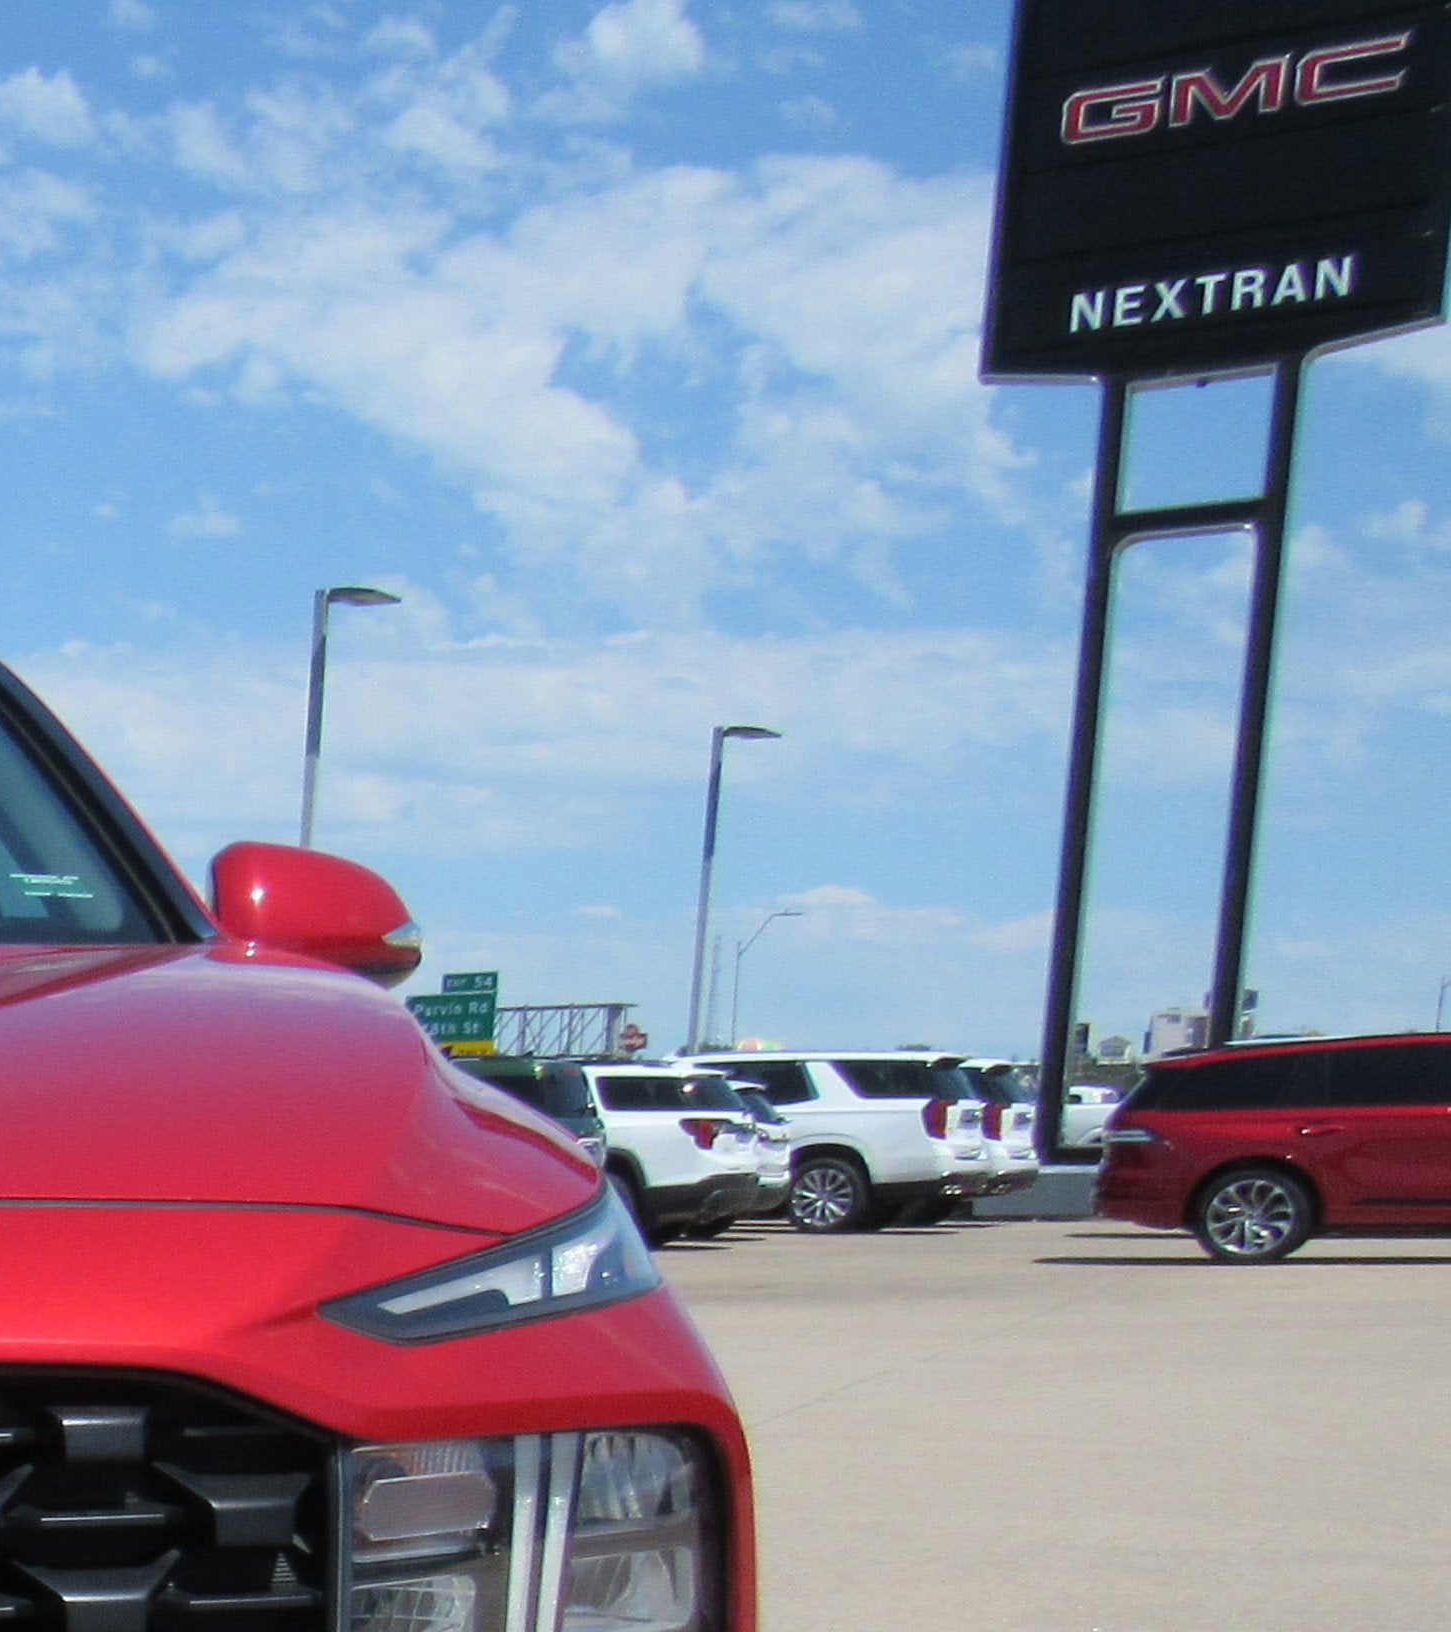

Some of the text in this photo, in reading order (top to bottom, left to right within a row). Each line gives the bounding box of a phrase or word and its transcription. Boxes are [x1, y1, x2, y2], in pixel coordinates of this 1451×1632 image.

[1061, 30, 1412, 144] GMC
[1069, 254, 1354, 333] NEXTRAN
[463, 1021, 479, 1034] St
[468, 1001, 489, 1014] Rd
